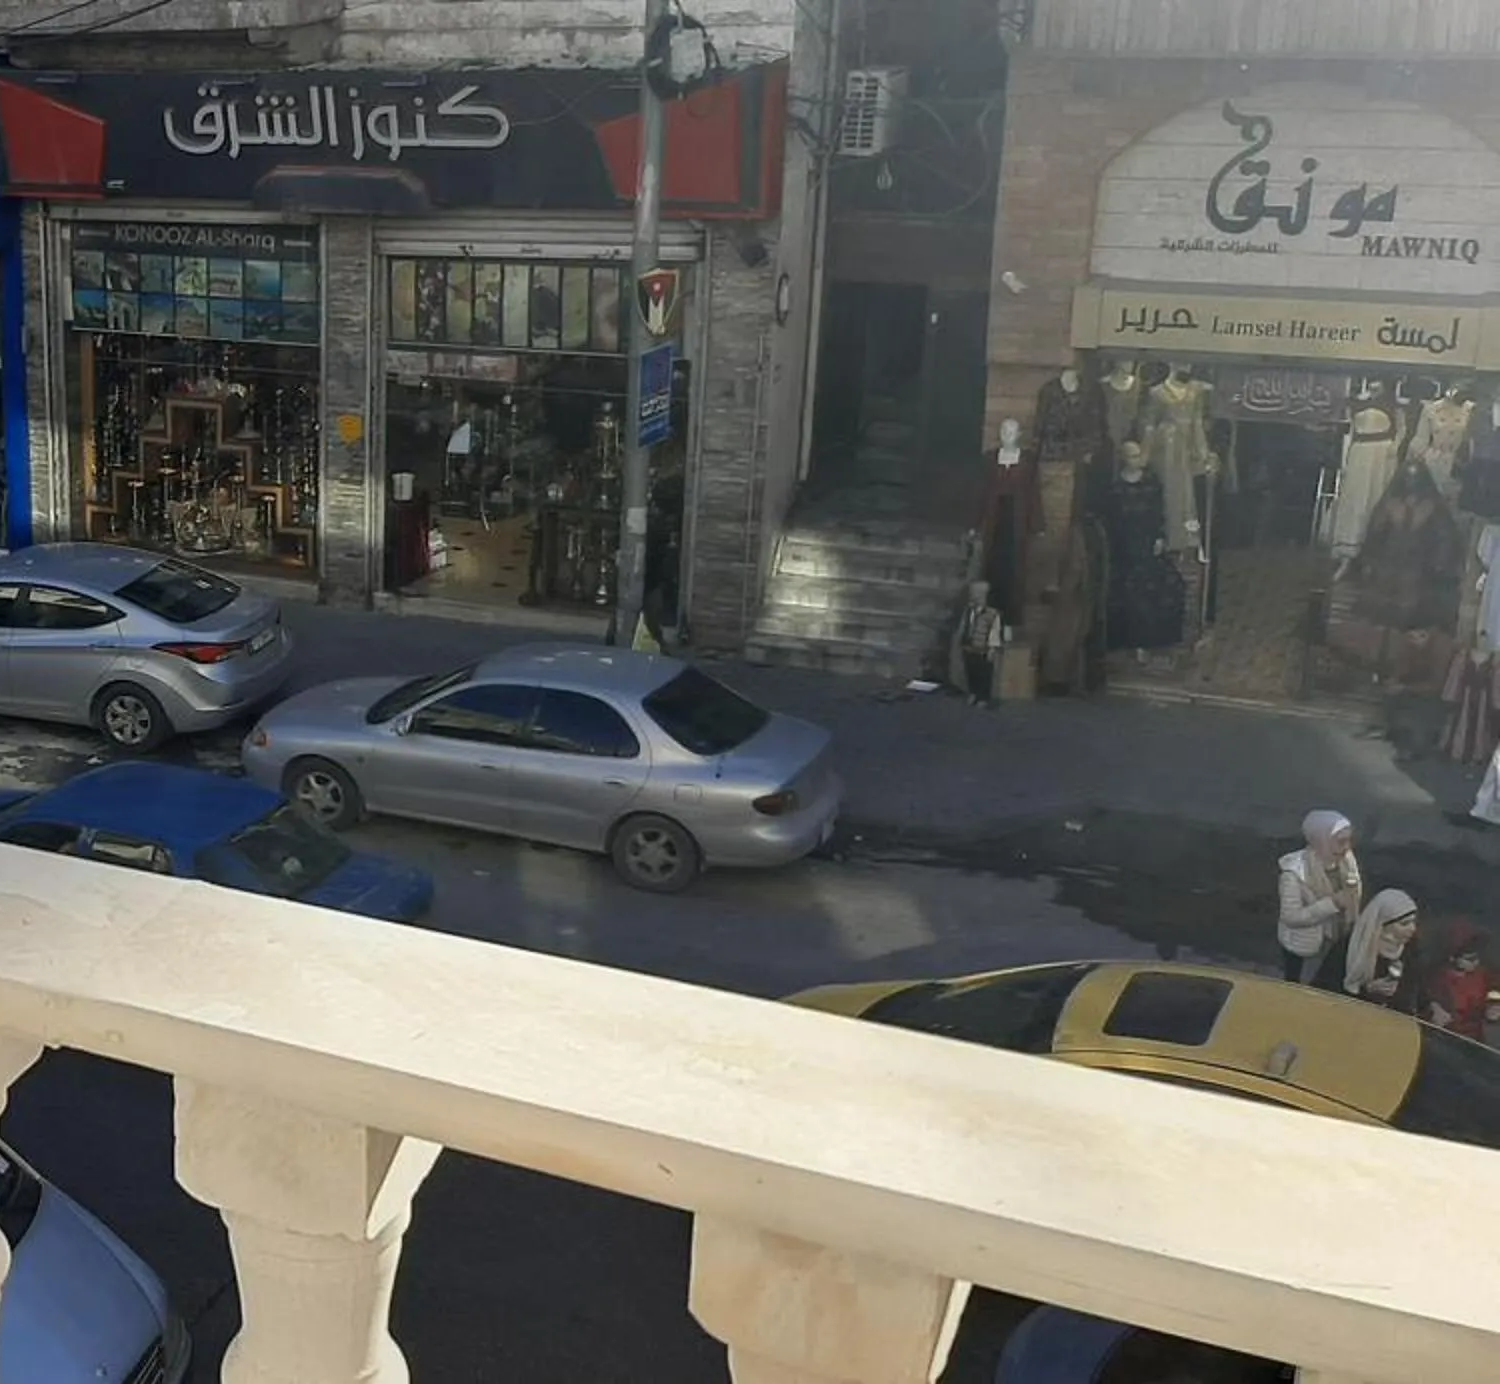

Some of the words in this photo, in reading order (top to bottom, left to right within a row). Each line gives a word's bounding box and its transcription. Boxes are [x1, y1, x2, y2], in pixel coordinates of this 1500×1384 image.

[163, 85, 339, 160] الشرق
[348, 85, 510, 161] كنوز
[114, 223, 191, 246] KONOOZ
[1360, 234, 1481, 264] MAWNIQ
[1115, 307, 1199, 334] حرير
[1288, 320, 1363, 343] Hareer
[1377, 315, 1461, 354] لمسة
